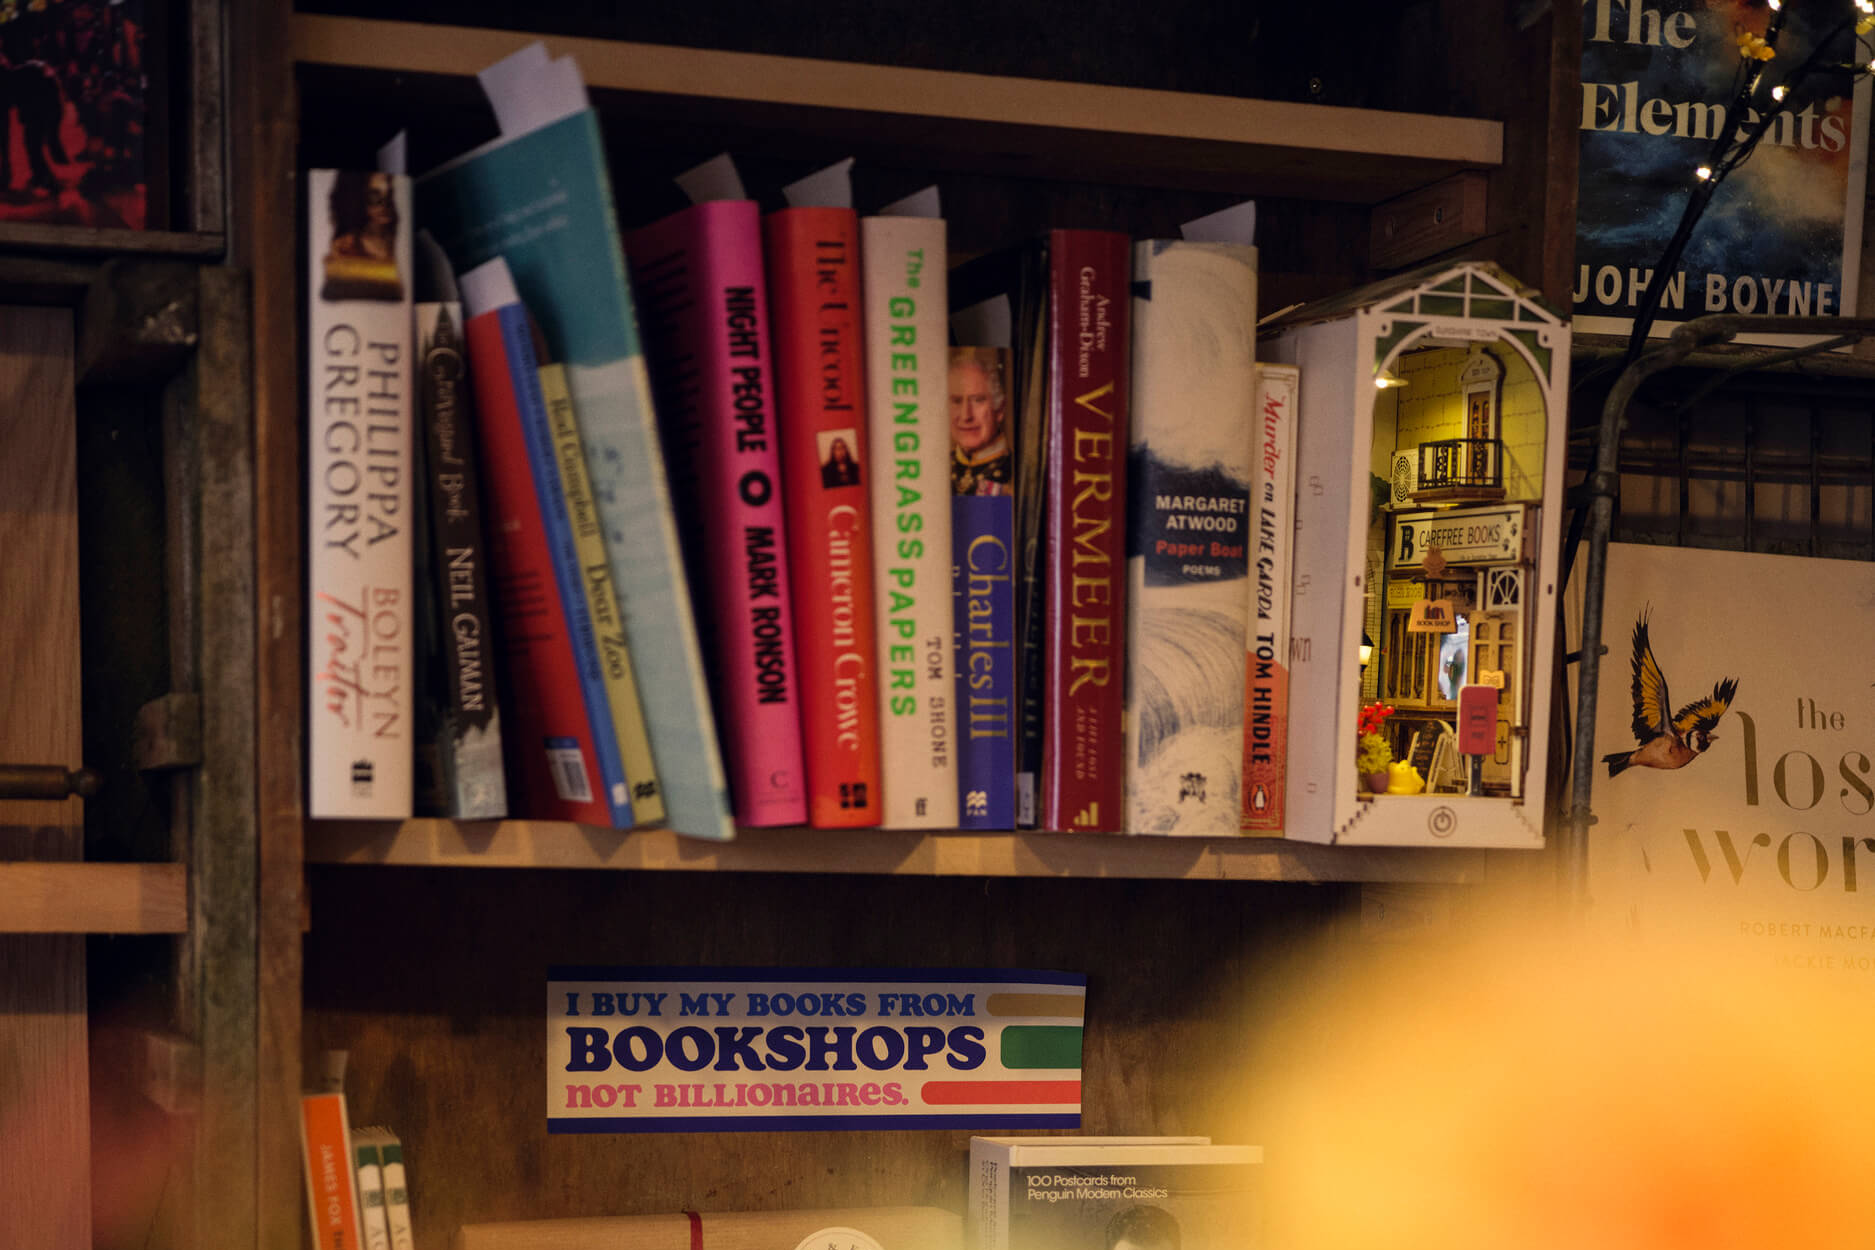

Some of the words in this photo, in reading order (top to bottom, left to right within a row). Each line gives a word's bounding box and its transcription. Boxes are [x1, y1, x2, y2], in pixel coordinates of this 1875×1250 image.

[1583, 0, 1697, 48] The
[1578, 80, 1846, 152] Elements
[816, 240, 846, 287] The
[906, 247, 924, 289] The
[1572, 264, 1687, 311] JOHN
[1704, 273, 1833, 316] BOYNE
[725, 286, 759, 359] NIGHT
[1079, 266, 1096, 378] Graham-Dixon
[1096, 293, 1112, 351] Andrew
[732, 366, 767, 453] PEOPLE
[888, 296, 924, 560] GREENGRASS
[1263, 392, 1286, 480] Murder
[324, 323, 360, 559] GREGORY
[366, 340, 399, 546] PHILIPPA
[559, 441, 598, 537] Campbell
[1155, 495, 1246, 513] MARGARET
[1263, 482, 1275, 502] on
[1067, 378, 1115, 696] VERMEER
[1155, 540, 1205, 558] Paper
[1209, 541, 1244, 559] Boat
[1165, 514, 1238, 533] ATWOOD
[1260, 508, 1276, 554] LAKE
[1419, 528, 1464, 548] CAREFREE
[1467, 524, 1501, 544] BOOKS
[446, 547, 476, 607] NEIL
[745, 526, 778, 600] MARK
[828, 504, 860, 648] Cameron
[1182, 563, 1221, 577] POEMS
[1256, 556, 1275, 620] GARDA
[587, 563, 613, 625] Dear
[602, 633, 627, 681] Zoo
[888, 567, 917, 717] PAPERS
[967, 534, 1009, 690] Charles
[316, 587, 370, 729] Traitor
[373, 587, 399, 739] BOLEYN
[452, 612, 484, 712] GAIMAN
[752, 605, 787, 705] RONSON
[926, 635, 944, 681] TOM
[1256, 633, 1274, 679] TOM
[834, 652, 865, 751] Crowe
[969, 696, 1008, 740] III
[1252, 688, 1272, 765] HINDLE
[1797, 697, 1845, 732] the
[929, 696, 948, 769] SHONE
[1739, 920, 1812, 938] ROBERT
[566, 993, 580, 1017] I
[592, 993, 668, 1017] BUY
[679, 993, 737, 1017] MY
[747, 993, 866, 1017] BOOKS
[878, 993, 976, 1017] FROM
[565, 1025, 987, 1072] BOOKSHOPS
[320, 1142, 338, 1192] JAMES
[1026, 1176, 1051, 1187] 100
[1053, 1175, 1108, 1187] Postcards
[1109, 1175, 1136, 1187] from
[1027, 1189, 1074, 1202] Penguin
[1076, 1188, 1121, 1200] Modern
[1122, 1187, 1168, 1199] Classics
[327, 1194, 342, 1226] FOX
